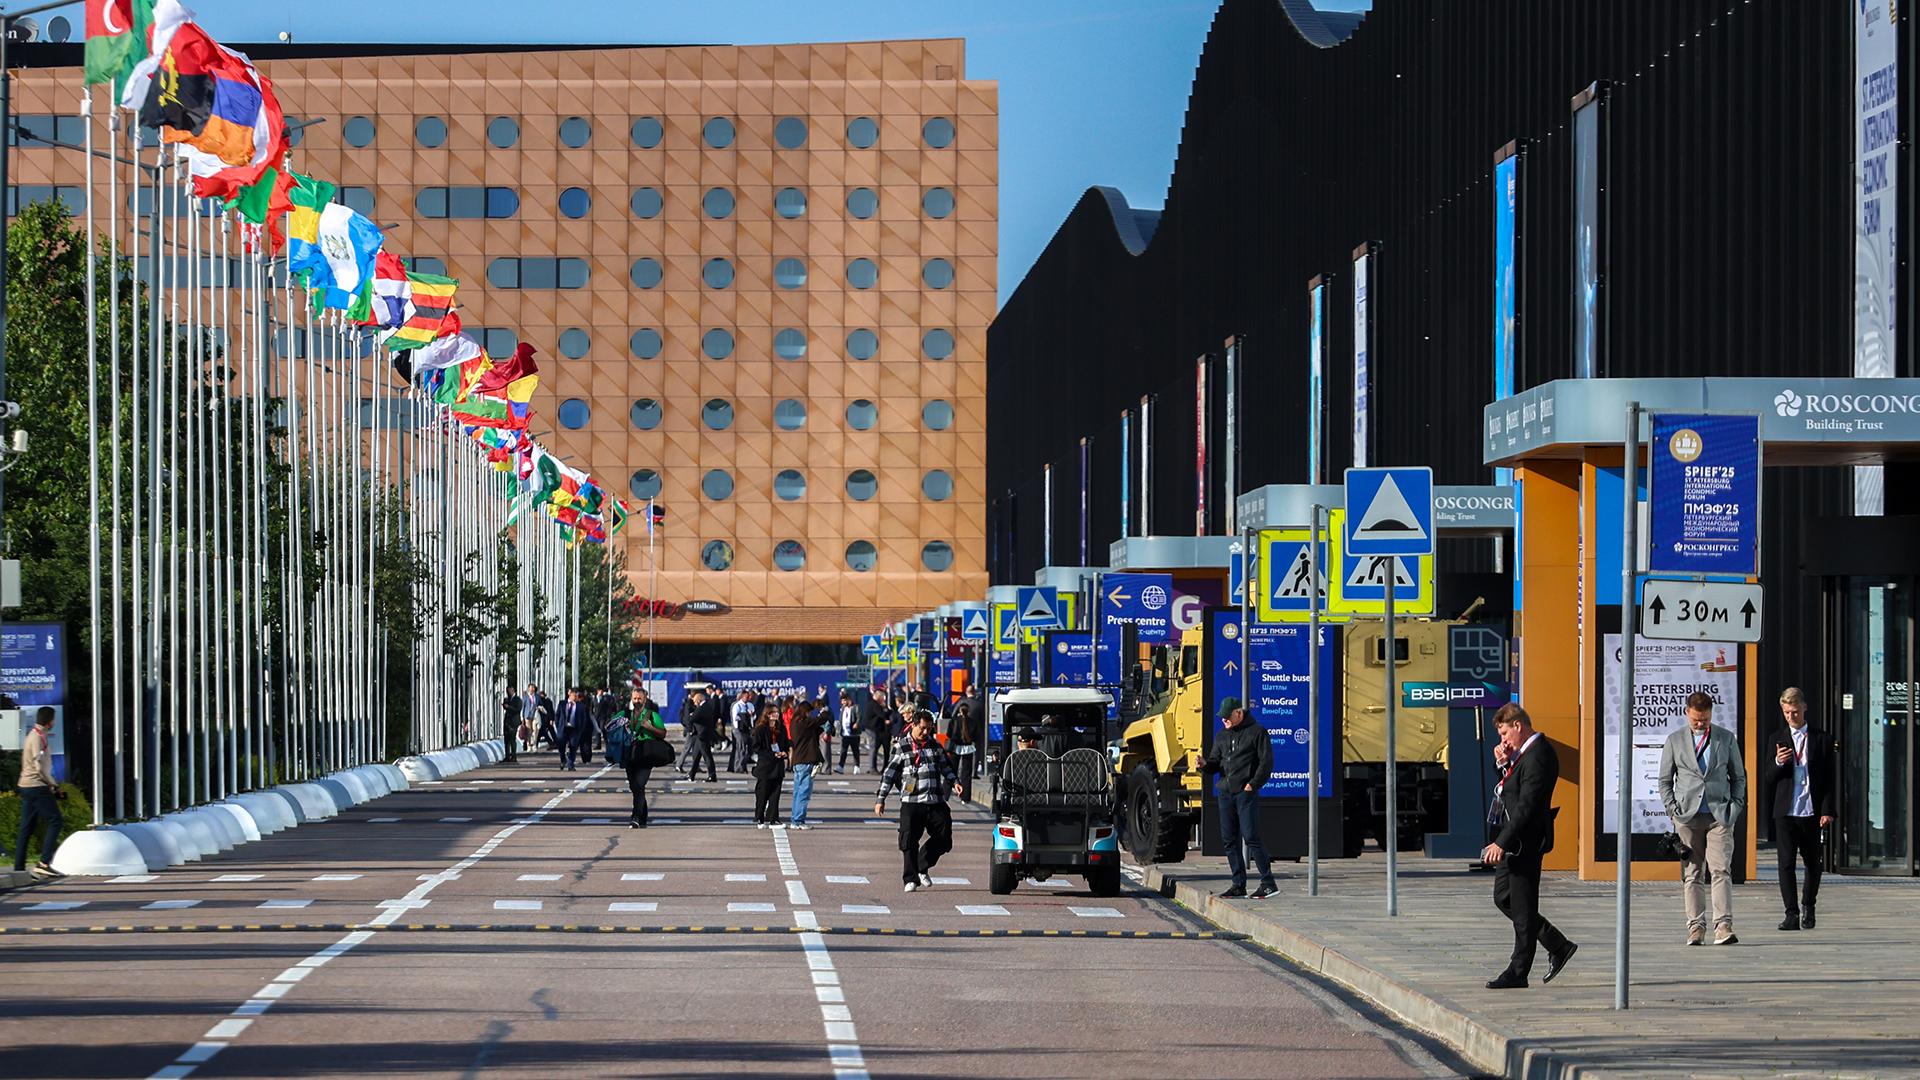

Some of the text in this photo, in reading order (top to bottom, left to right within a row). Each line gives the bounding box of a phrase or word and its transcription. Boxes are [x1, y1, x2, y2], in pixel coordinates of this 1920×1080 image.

[1805, 394, 1920, 413] ROSCONG
[1806, 418, 1883, 433] Building Trust
[1685, 465, 1735, 478] SPIEF'25
[1435, 496, 1514, 510] OSCONGR
[1684, 503, 1739, 515] ПМЭФ'25
[1107, 615, 1166, 626] Press centre
[1, 666, 47, 676] ТЕРБУРГСКИЙ
[721, 677, 793, 688] ПЕТЕРБУРГСКИЙ
[1262, 673, 1311, 682] Shuttle buse
[1641, 684, 1719, 695] PETERSBURG
[1262, 697, 1298, 706] VinoGrad
[1632, 717, 1668, 727] ORUM
